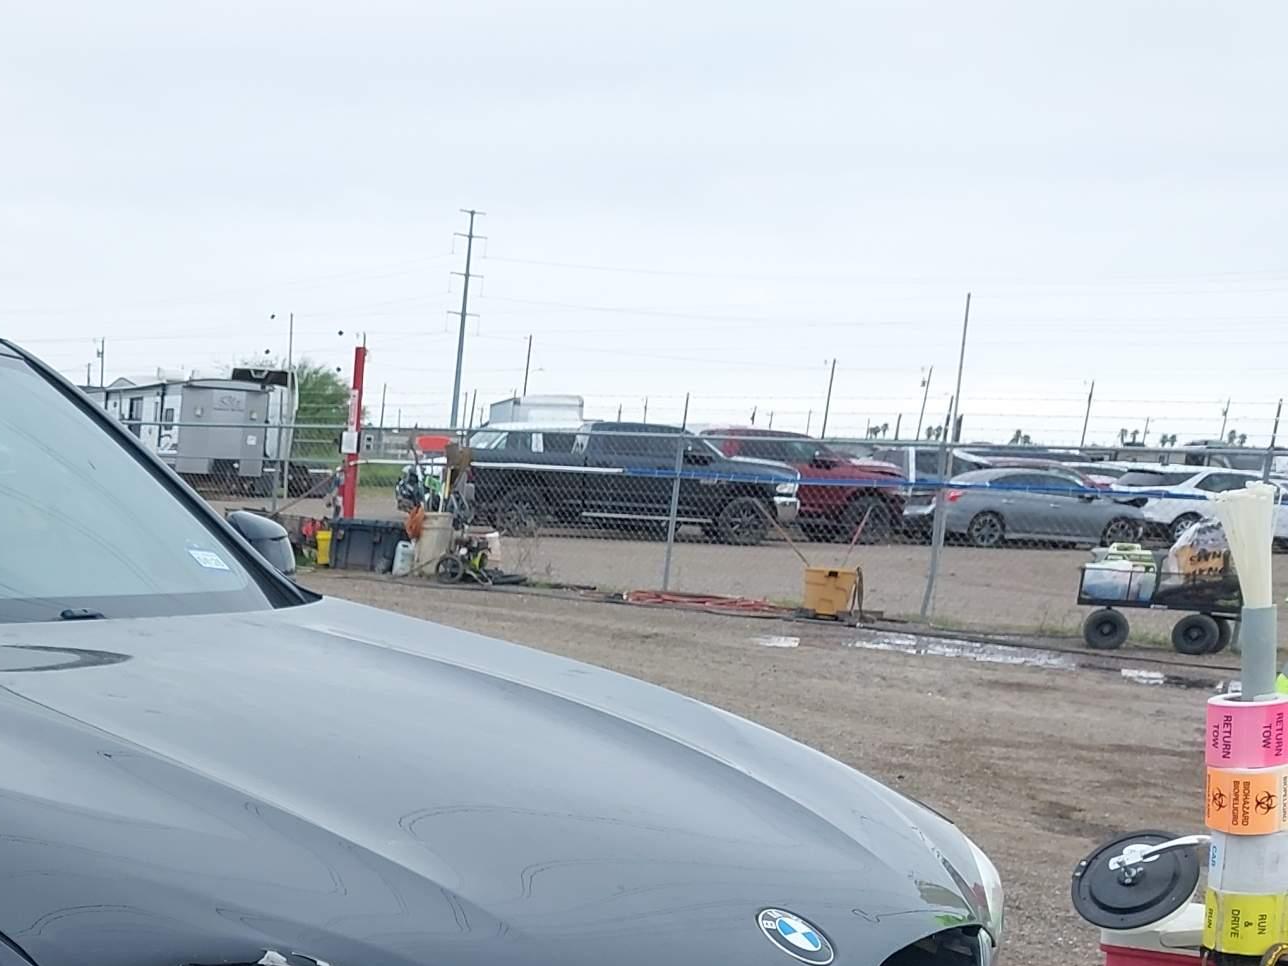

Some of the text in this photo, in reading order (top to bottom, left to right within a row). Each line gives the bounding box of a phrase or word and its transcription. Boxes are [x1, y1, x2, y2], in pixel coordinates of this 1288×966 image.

[1212, 724, 1220, 749] TOW
[1222, 715, 1233, 759] RETURN
[1262, 723, 1272, 749] TOW
[1274, 712, 1284, 757] RETURN
[1232, 780, 1240, 826] BIOPELIGRO
[1241, 781, 1250, 826] BIOHAZARD
[1230, 909, 1240, 938] DRIVE
[1257, 914, 1267, 935] RUN
